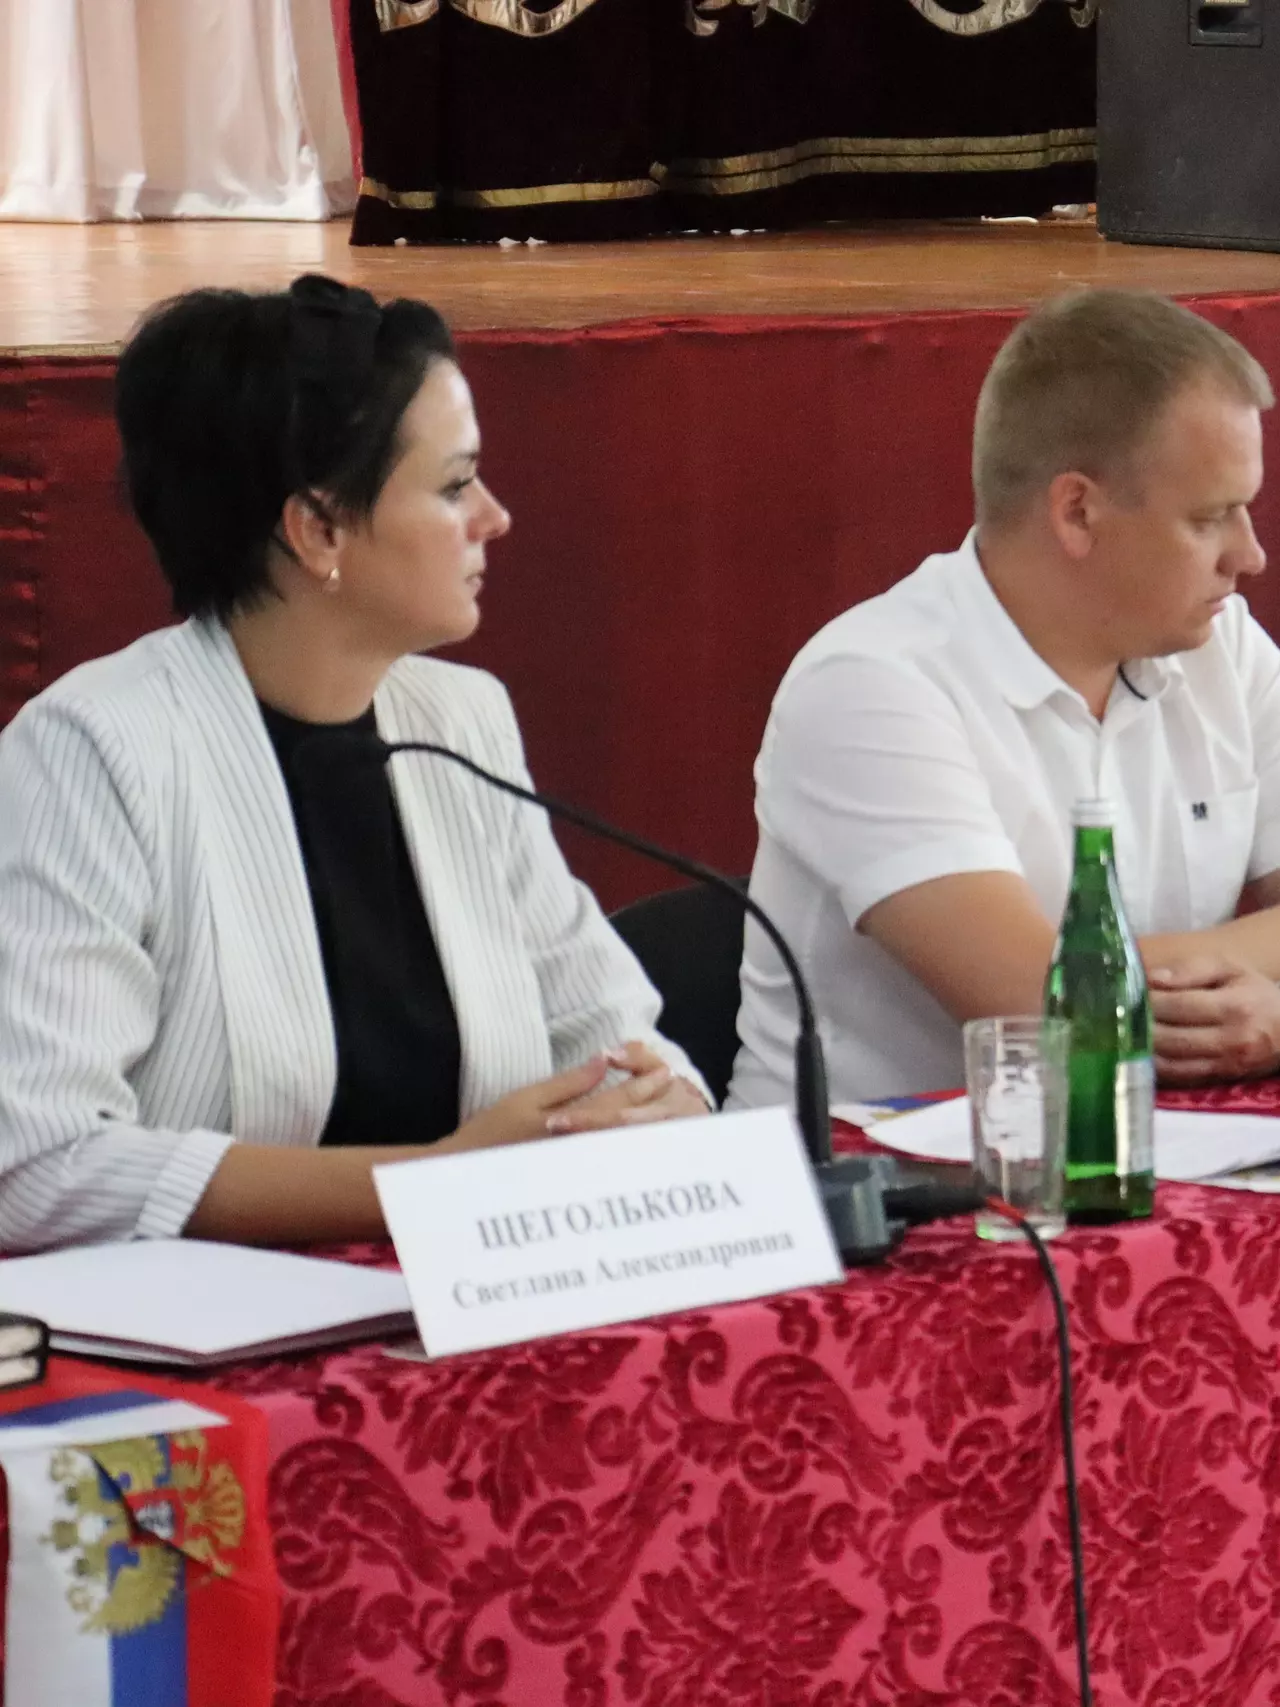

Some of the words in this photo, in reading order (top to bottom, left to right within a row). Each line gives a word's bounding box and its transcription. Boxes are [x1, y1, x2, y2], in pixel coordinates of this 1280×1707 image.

[476, 1179, 744, 1251] ЩЕГОЛЬКОВА
[452, 1264, 587, 1310] Светлана
[594, 1230, 796, 1285] Александровна
